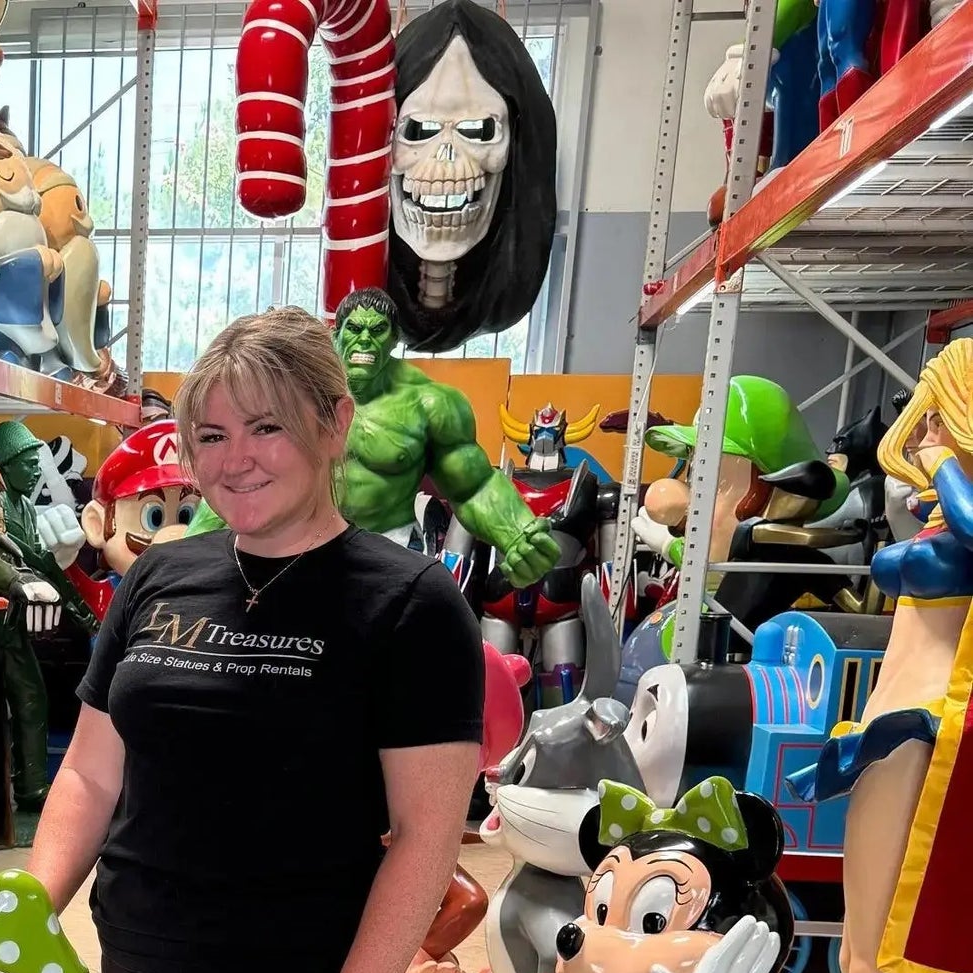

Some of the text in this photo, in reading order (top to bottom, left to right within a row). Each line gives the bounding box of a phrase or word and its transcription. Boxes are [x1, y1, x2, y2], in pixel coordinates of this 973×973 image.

[140, 602, 325, 655] LM Treasures
[138, 652, 162, 664] Size
[164, 656, 210, 671] Statues
[213, 662, 222, 672] &
[226, 663, 256, 676] Prop
[260, 664, 313, 677] Rentals
